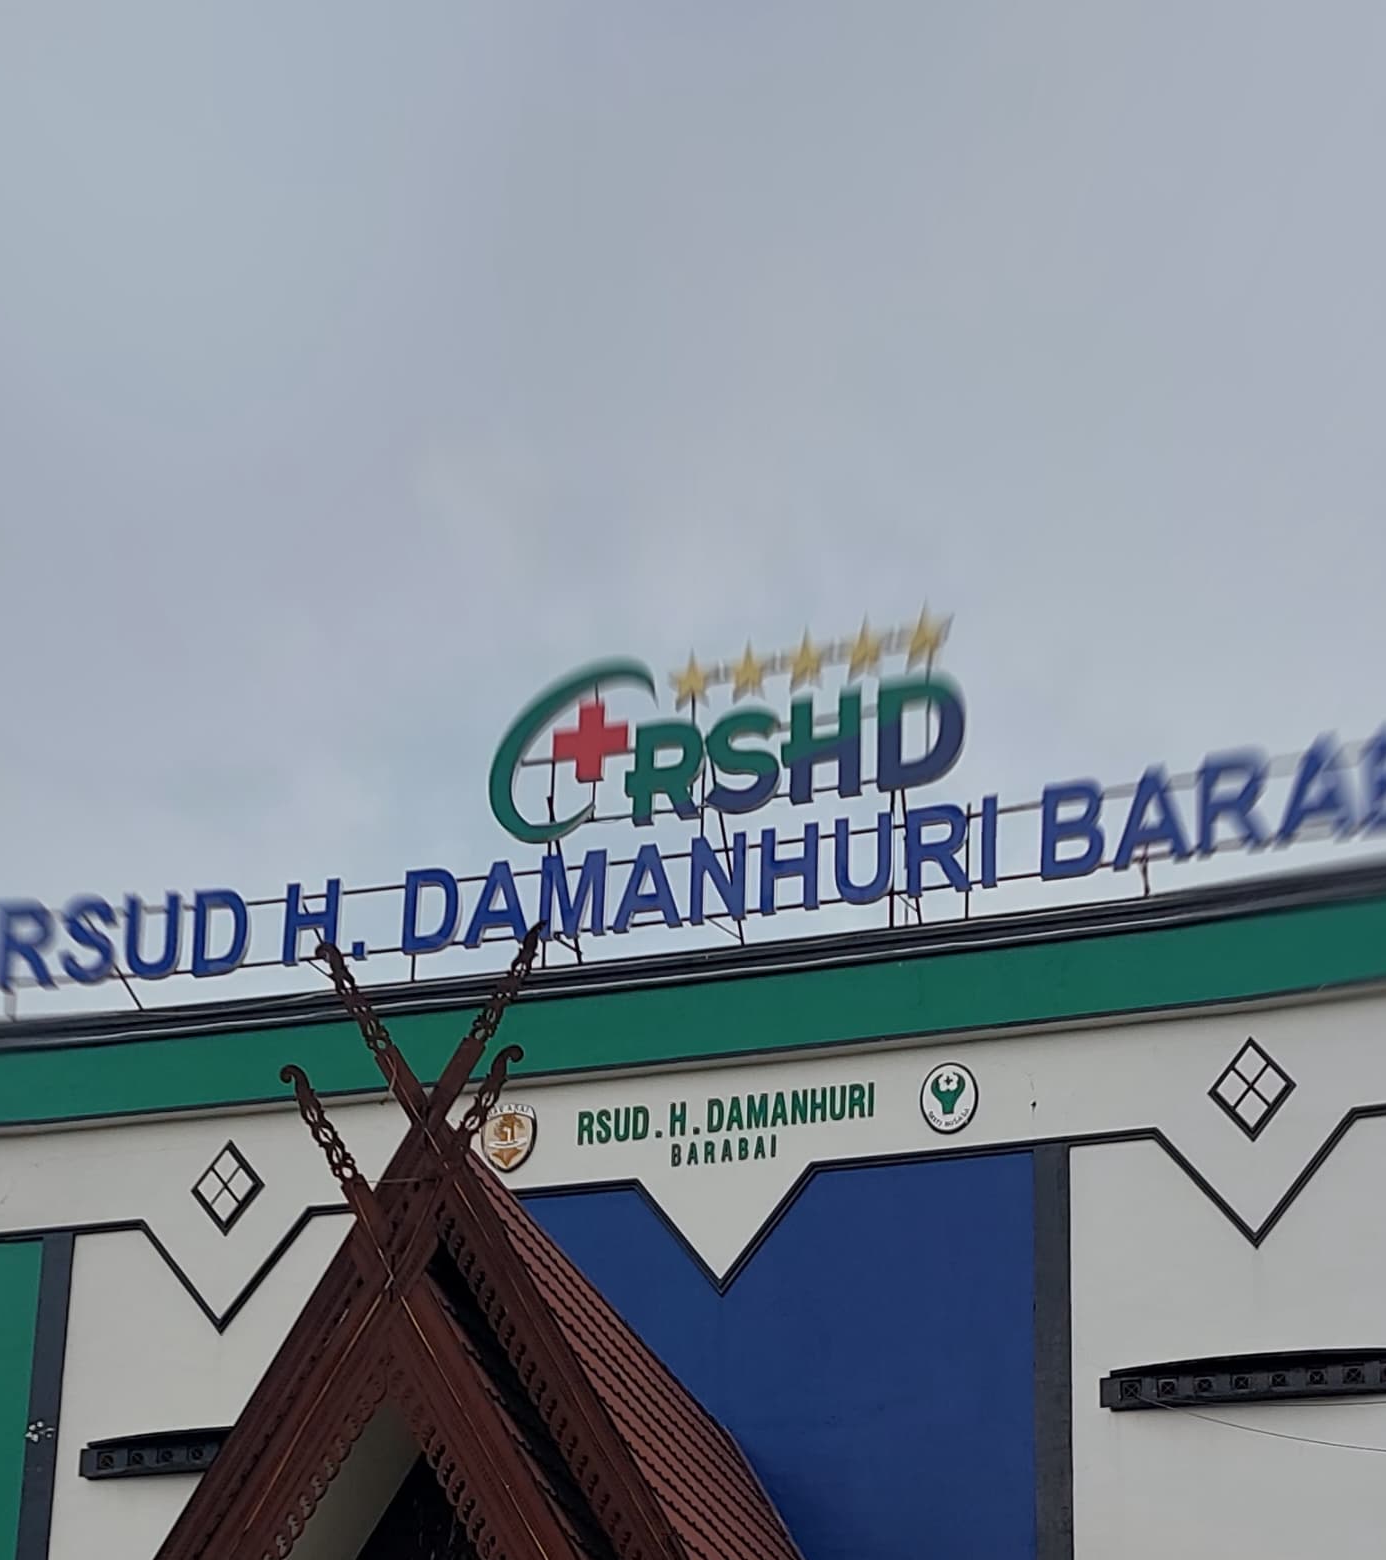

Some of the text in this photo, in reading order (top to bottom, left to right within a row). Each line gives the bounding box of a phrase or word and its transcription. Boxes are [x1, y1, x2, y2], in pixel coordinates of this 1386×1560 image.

[282, 876, 369, 967] H.
[400, 793, 998, 956] DAMANHURI
[670, 1134, 777, 1168] BARABAI
